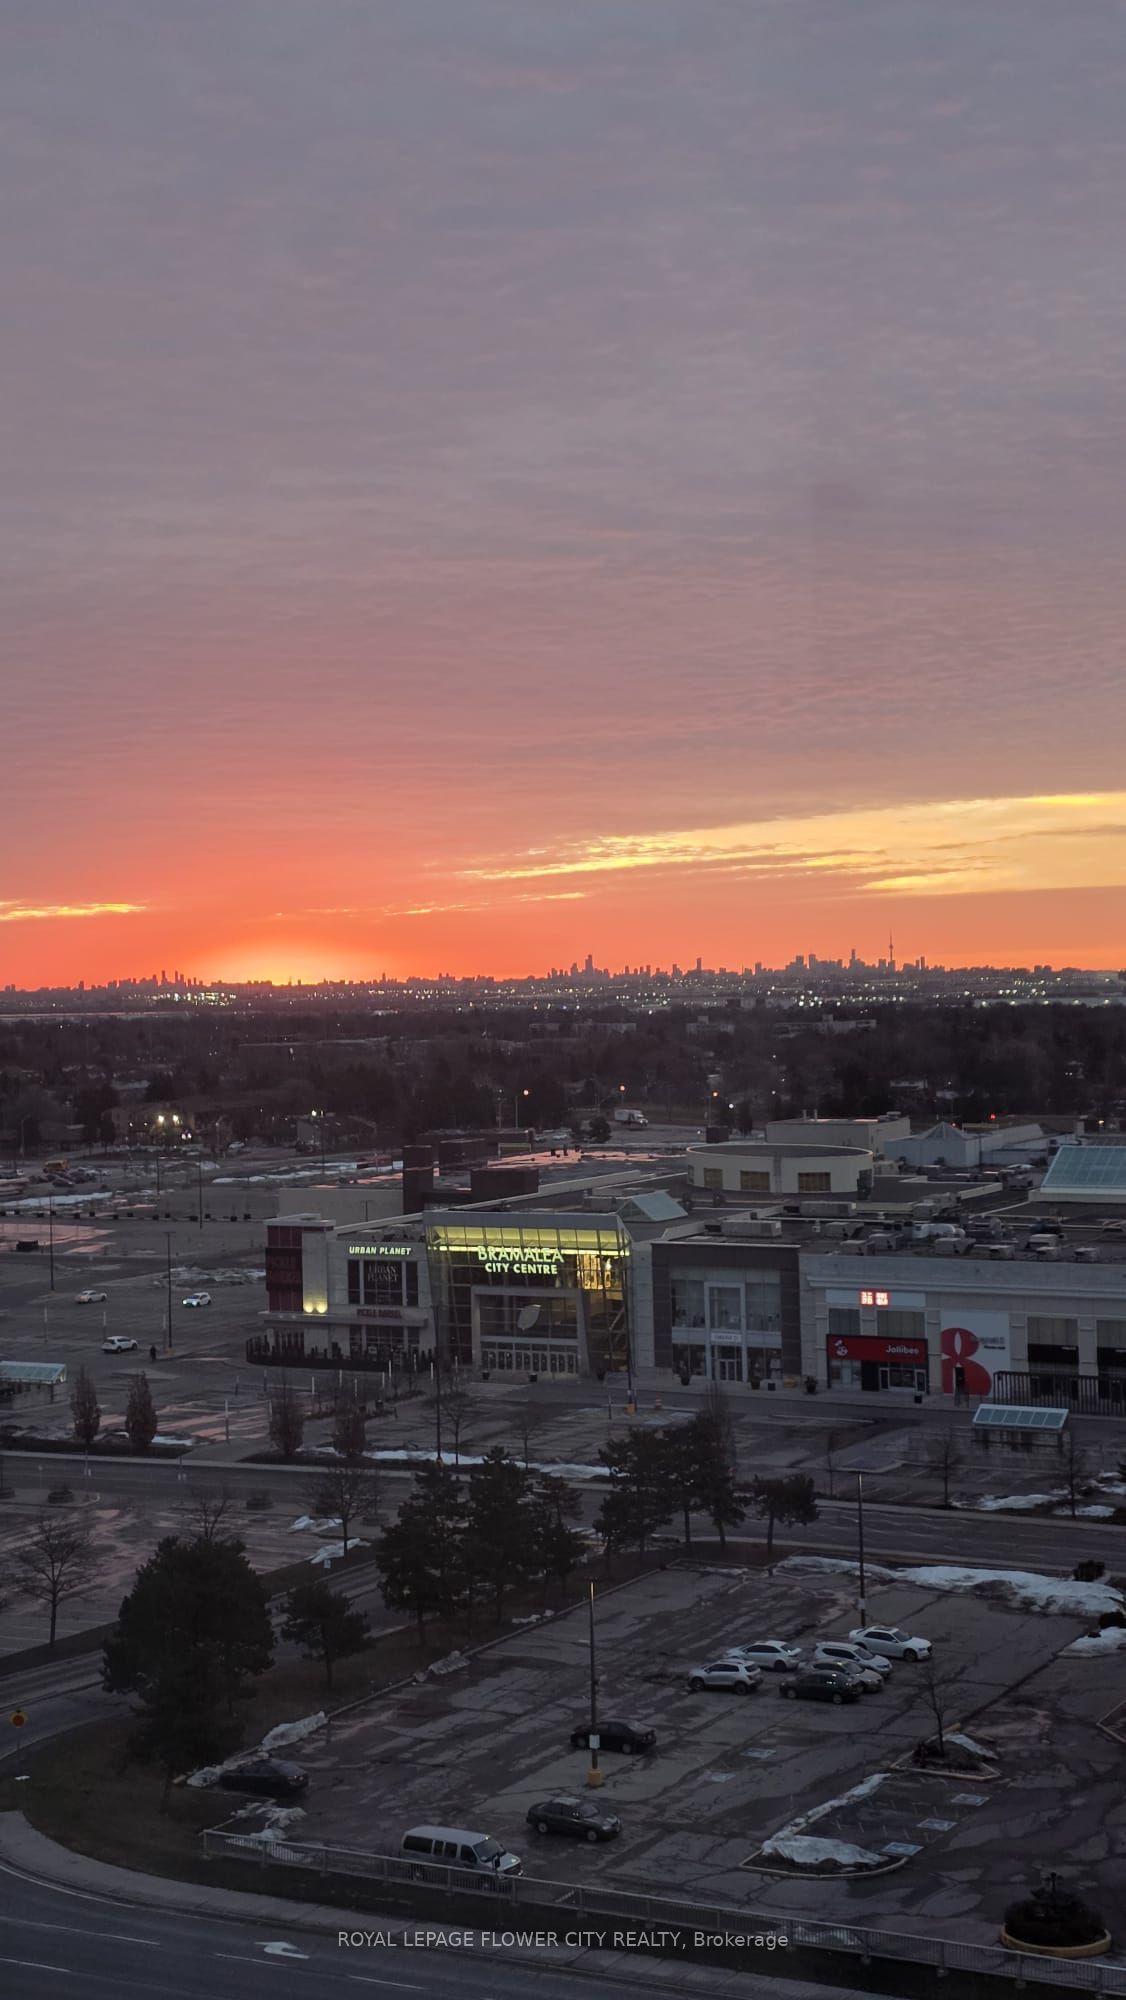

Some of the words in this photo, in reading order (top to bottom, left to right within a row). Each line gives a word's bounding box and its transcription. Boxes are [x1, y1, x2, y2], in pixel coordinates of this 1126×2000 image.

[349, 1246, 377, 1255] URBAN
[379, 1247, 412, 1256] PLANET
[477, 1245, 564, 1263] BRAMALEA
[485, 1262, 509, 1273] CITY
[513, 1263, 558, 1275] CENTRE
[885, 1345, 919, 1355] Jollibee
